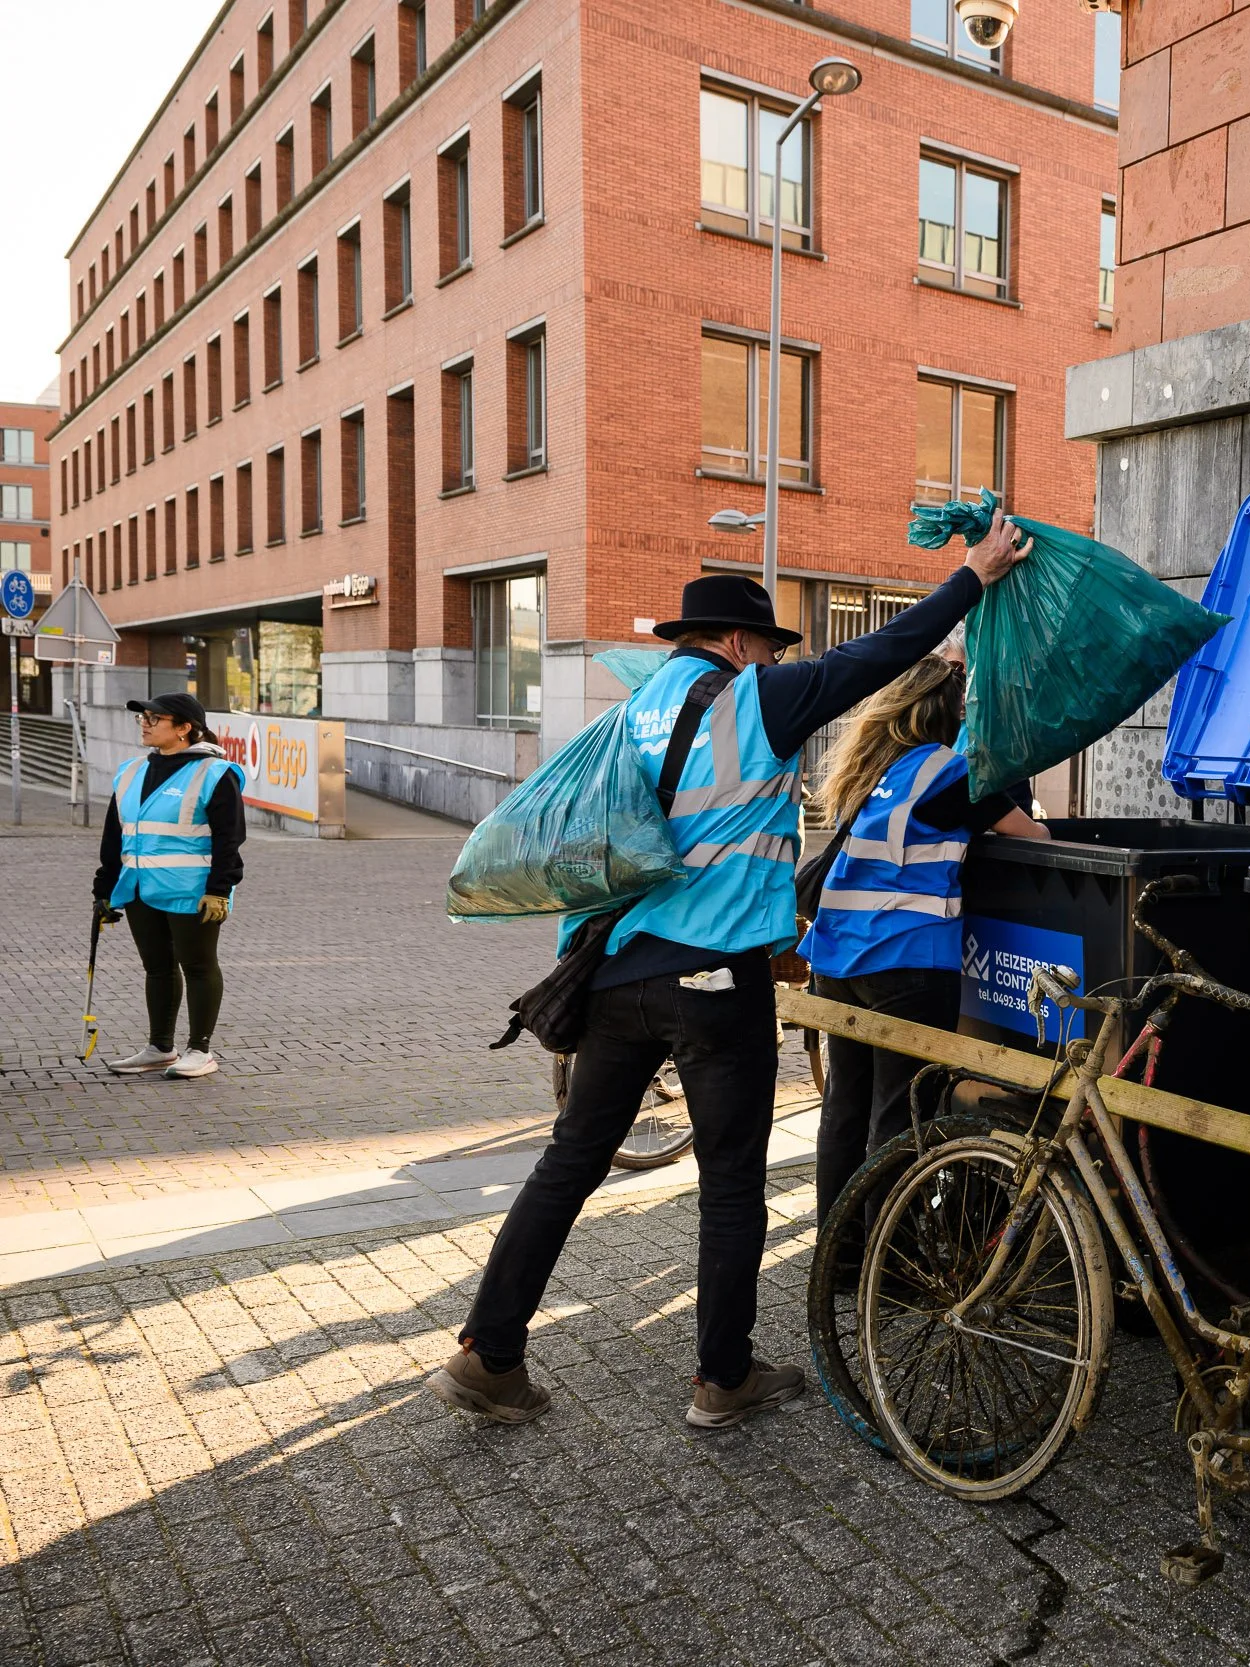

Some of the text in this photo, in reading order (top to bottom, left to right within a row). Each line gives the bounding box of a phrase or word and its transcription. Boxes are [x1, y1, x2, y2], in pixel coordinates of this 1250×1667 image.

[635, 704, 683, 726] MAAS
[627, 717, 677, 739] LEAN
[996, 970, 1032, 992] CONTA
[979, 988, 991, 1002] tel.
[993, 991, 1026, 1012] 0492-36
